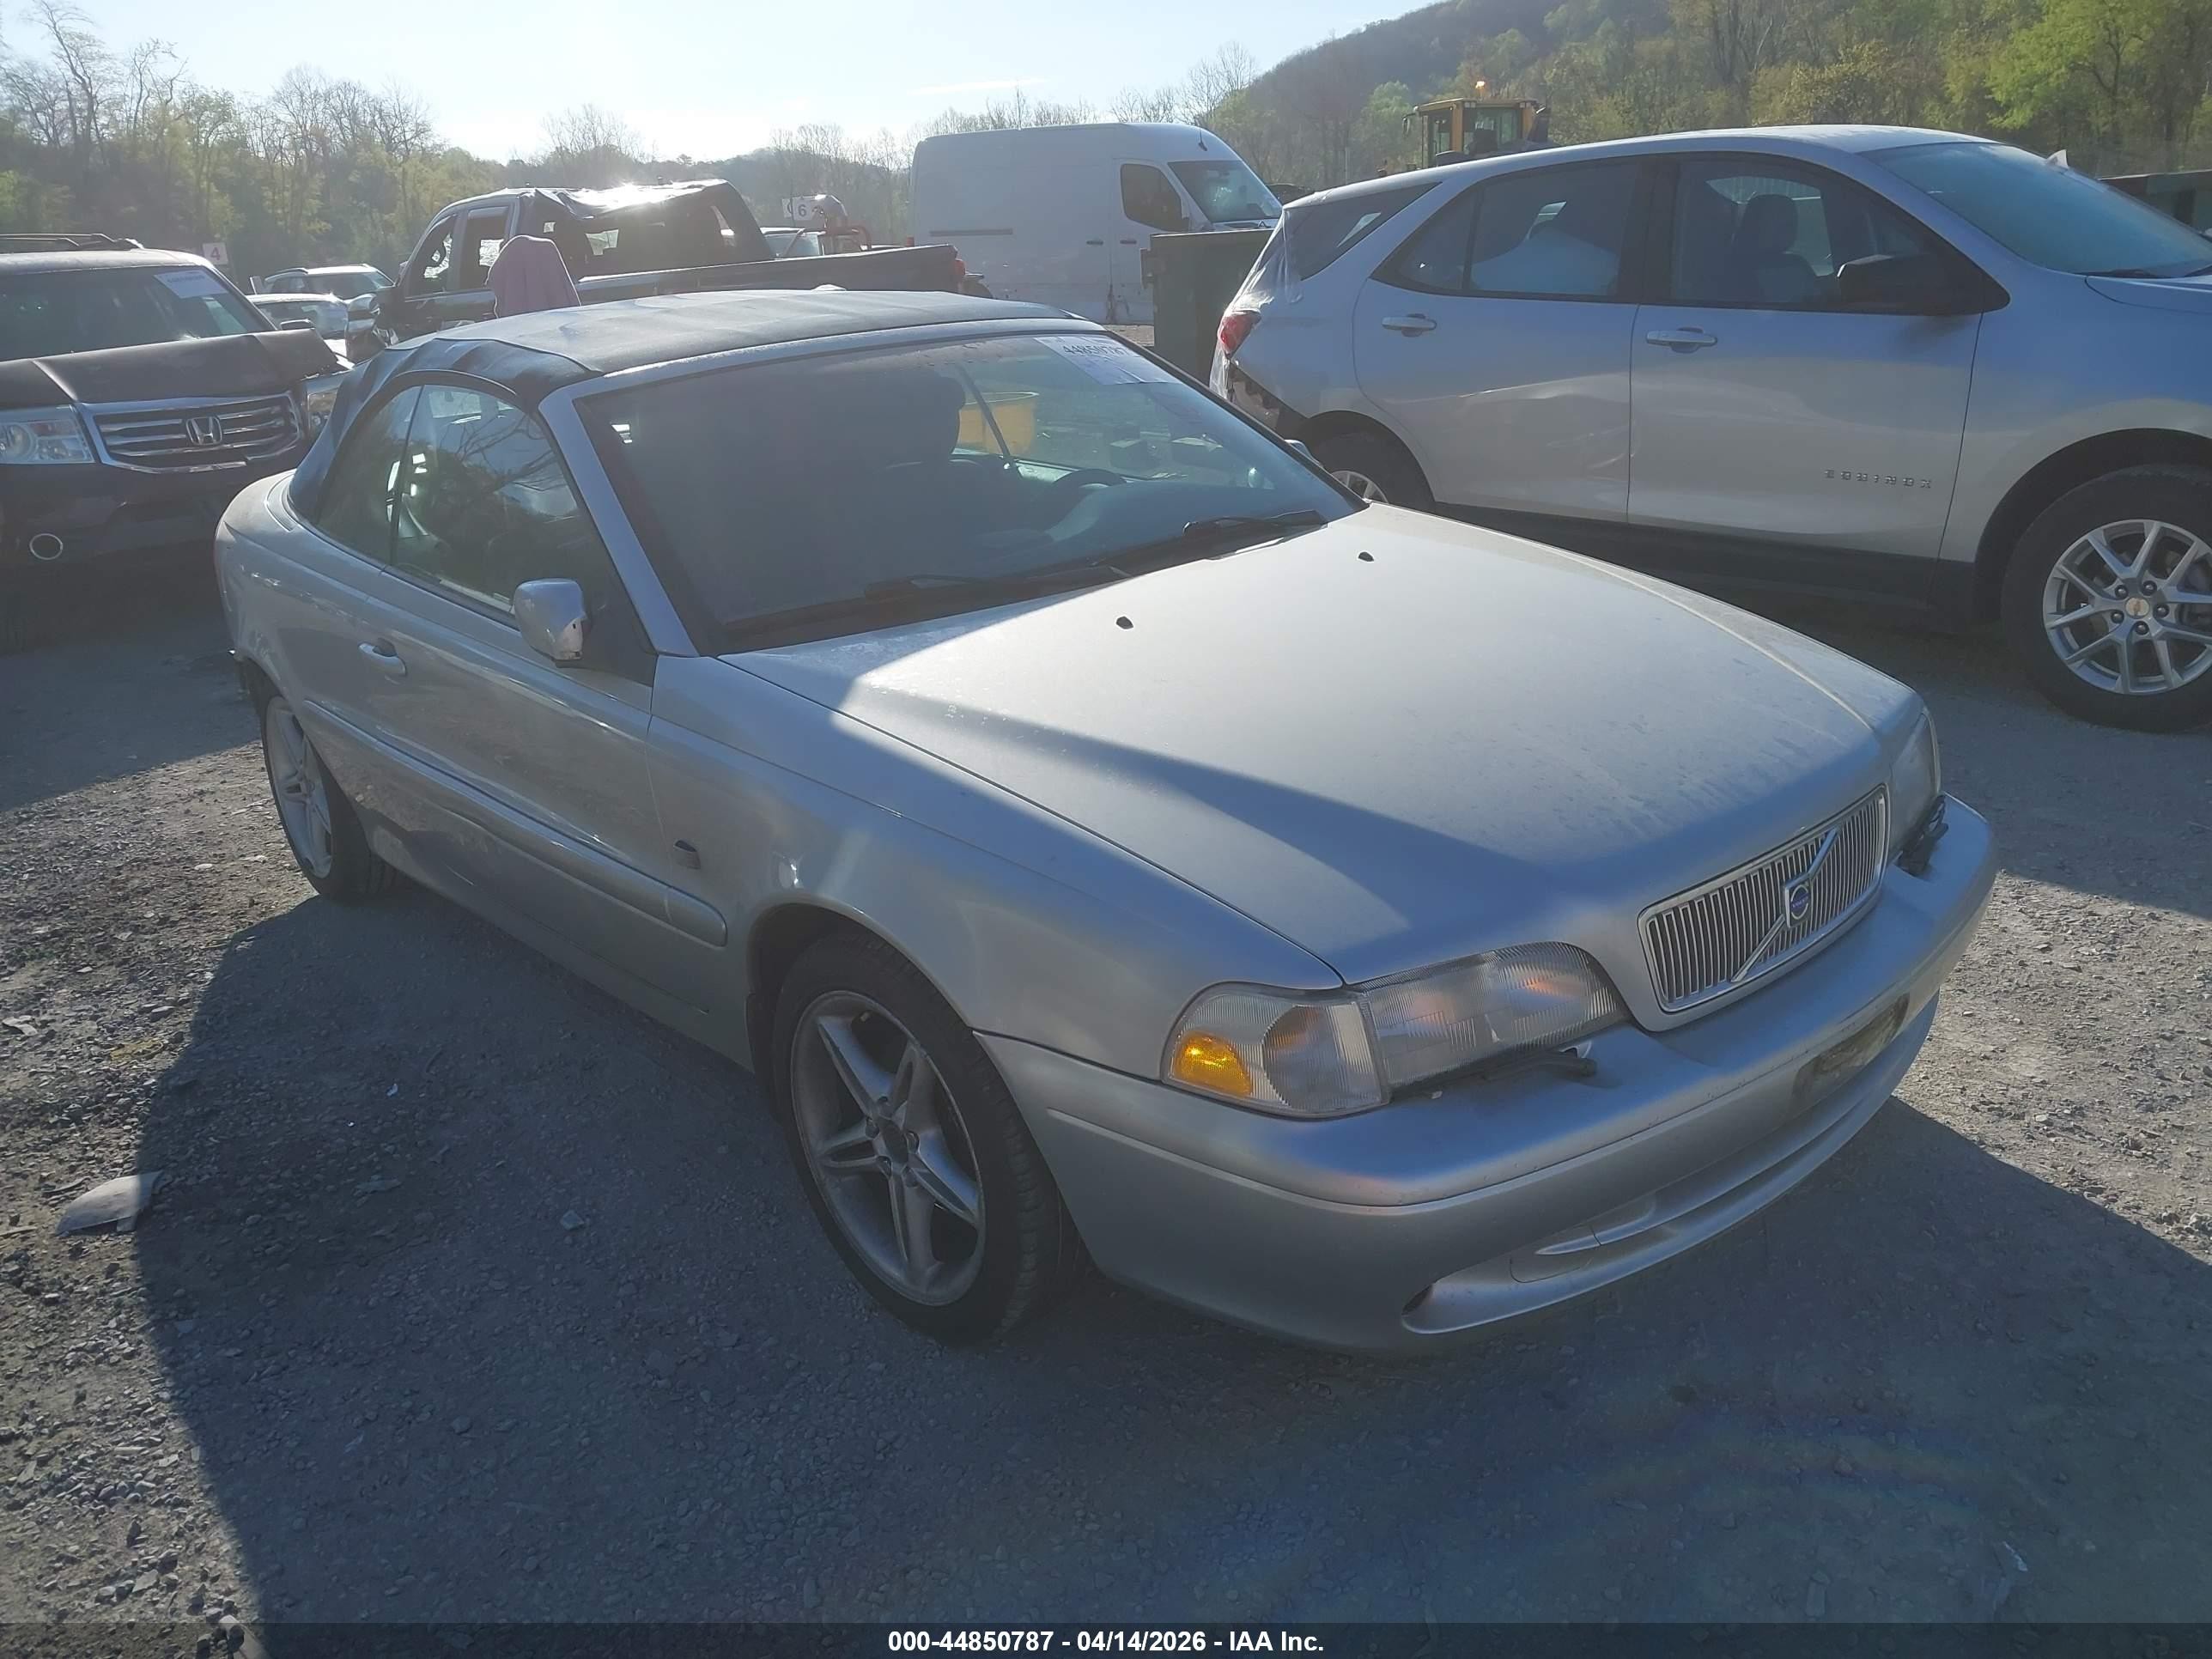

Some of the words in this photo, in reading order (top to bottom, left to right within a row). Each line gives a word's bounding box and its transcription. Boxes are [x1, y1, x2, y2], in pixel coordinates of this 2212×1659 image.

[798, 204, 807, 217] 6
[210, 246, 221, 261] 4
[1824, 469, 1932, 489] EQUINOX
